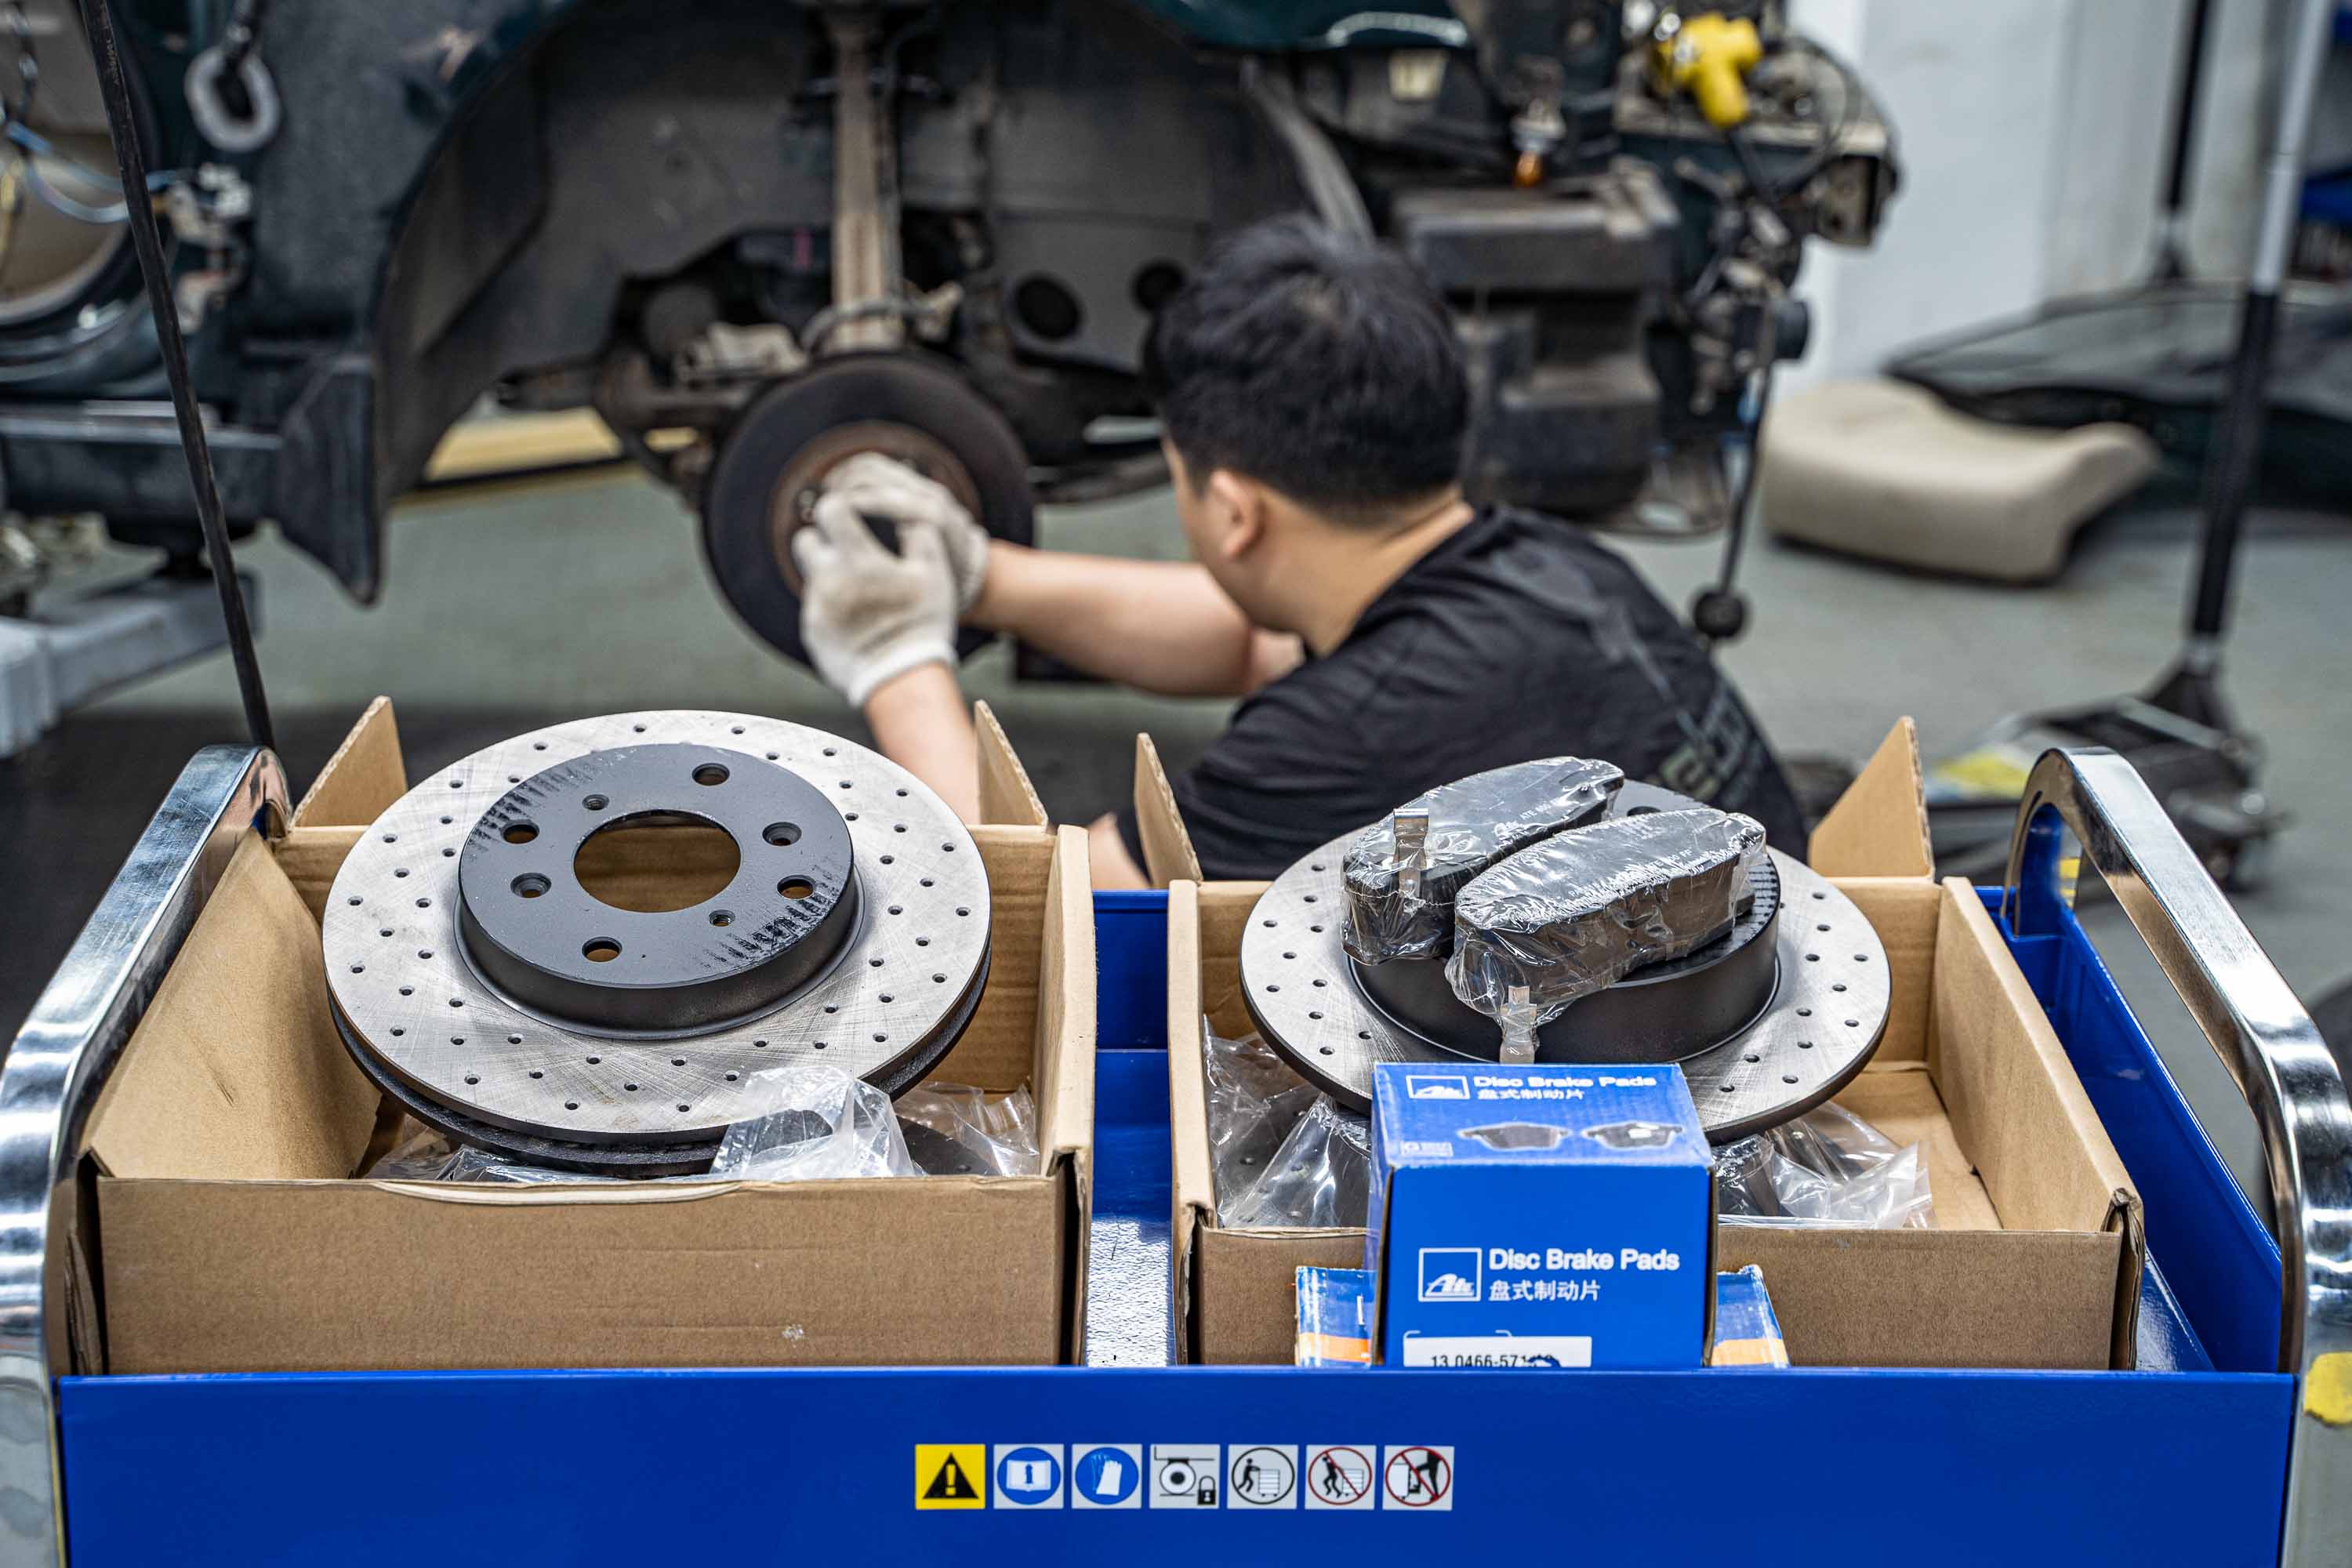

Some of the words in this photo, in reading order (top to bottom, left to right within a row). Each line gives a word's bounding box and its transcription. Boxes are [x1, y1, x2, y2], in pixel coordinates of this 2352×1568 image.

[1474, 1076, 1523, 1087] Disc
[1528, 1076, 1594, 1087] Brake
[1599, 1076, 1657, 1087] Pads
[1477, 1089, 1584, 1100] 盘式制动片
[1489, 1248, 1541, 1270] Disc
[1546, 1248, 1614, 1270] Brake
[1621, 1248, 1680, 1270] Pads
[1488, 1279, 1601, 1301] 盘式制动片
